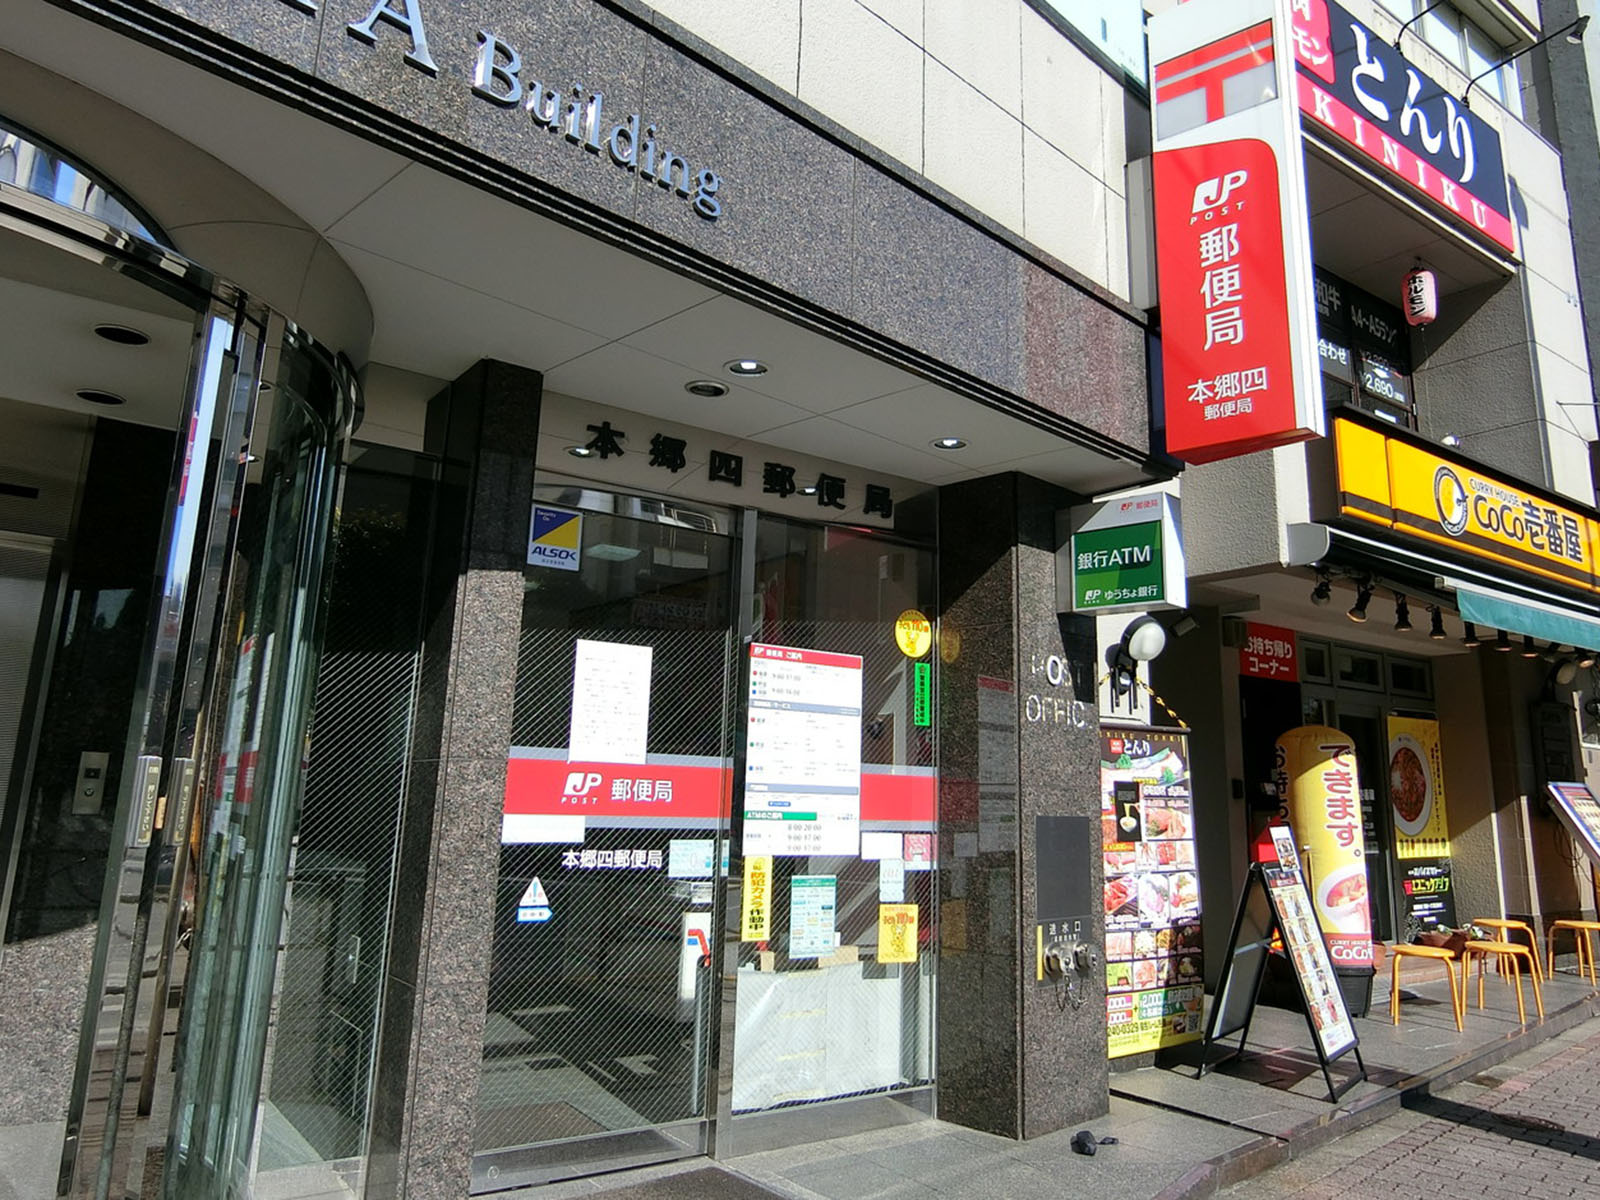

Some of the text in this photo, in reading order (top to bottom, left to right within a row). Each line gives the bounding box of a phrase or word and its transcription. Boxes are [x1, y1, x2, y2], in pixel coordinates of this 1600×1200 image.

[1350, 23, 1476, 184] とんり
[470, 30, 723, 220] Building
[1312, 87, 1487, 229] KINIKU
[1189, 200, 1244, 226] POST
[1200, 223, 1244, 351] 郵便局
[1187, 366, 1268, 414] 本郷四
[1203, 398, 1253, 421] 郵便局
[585, 420, 893, 519] 本郷四郵便局
[1469, 478, 1521, 507] CURRY HOUSE
[531, 545, 578, 562] ALSOK
[1077, 545, 1152, 571] 銀行ATM
[1104, 584, 1159, 601] ゆうちょ銀行
[1249, 656, 1290, 676] コーナー
[1123, 738, 1150, 756] とんり
[561, 797, 598, 805] POST
[610, 778, 673, 803] 郵便局
[1319, 744, 1363, 858] できます。
[561, 848, 663, 869] 本郷四郵便局
